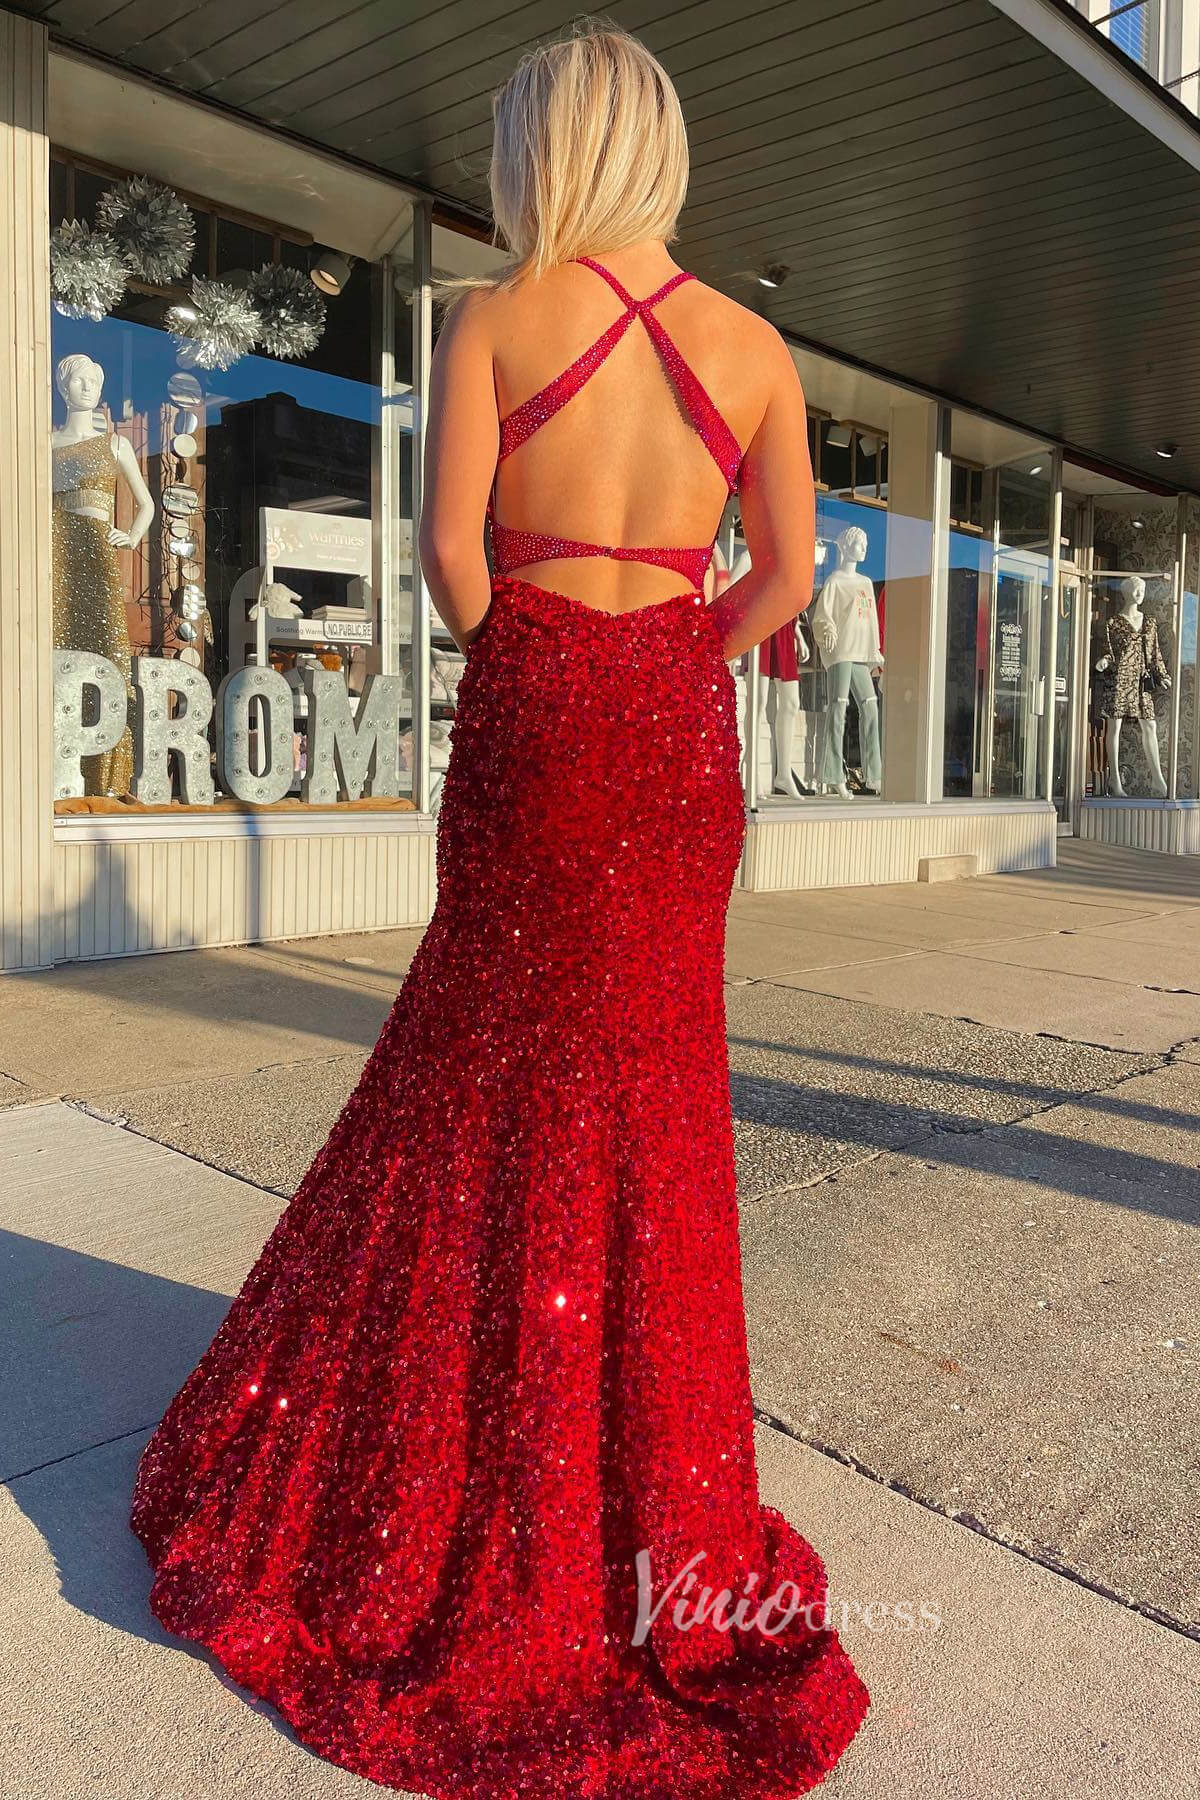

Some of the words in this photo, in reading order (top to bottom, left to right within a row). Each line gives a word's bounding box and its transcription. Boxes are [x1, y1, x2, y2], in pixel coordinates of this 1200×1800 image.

[328, 623, 338, 635] NO
[339, 624, 362, 637] PUBLIC
[53, 649, 401, 806] PROM
